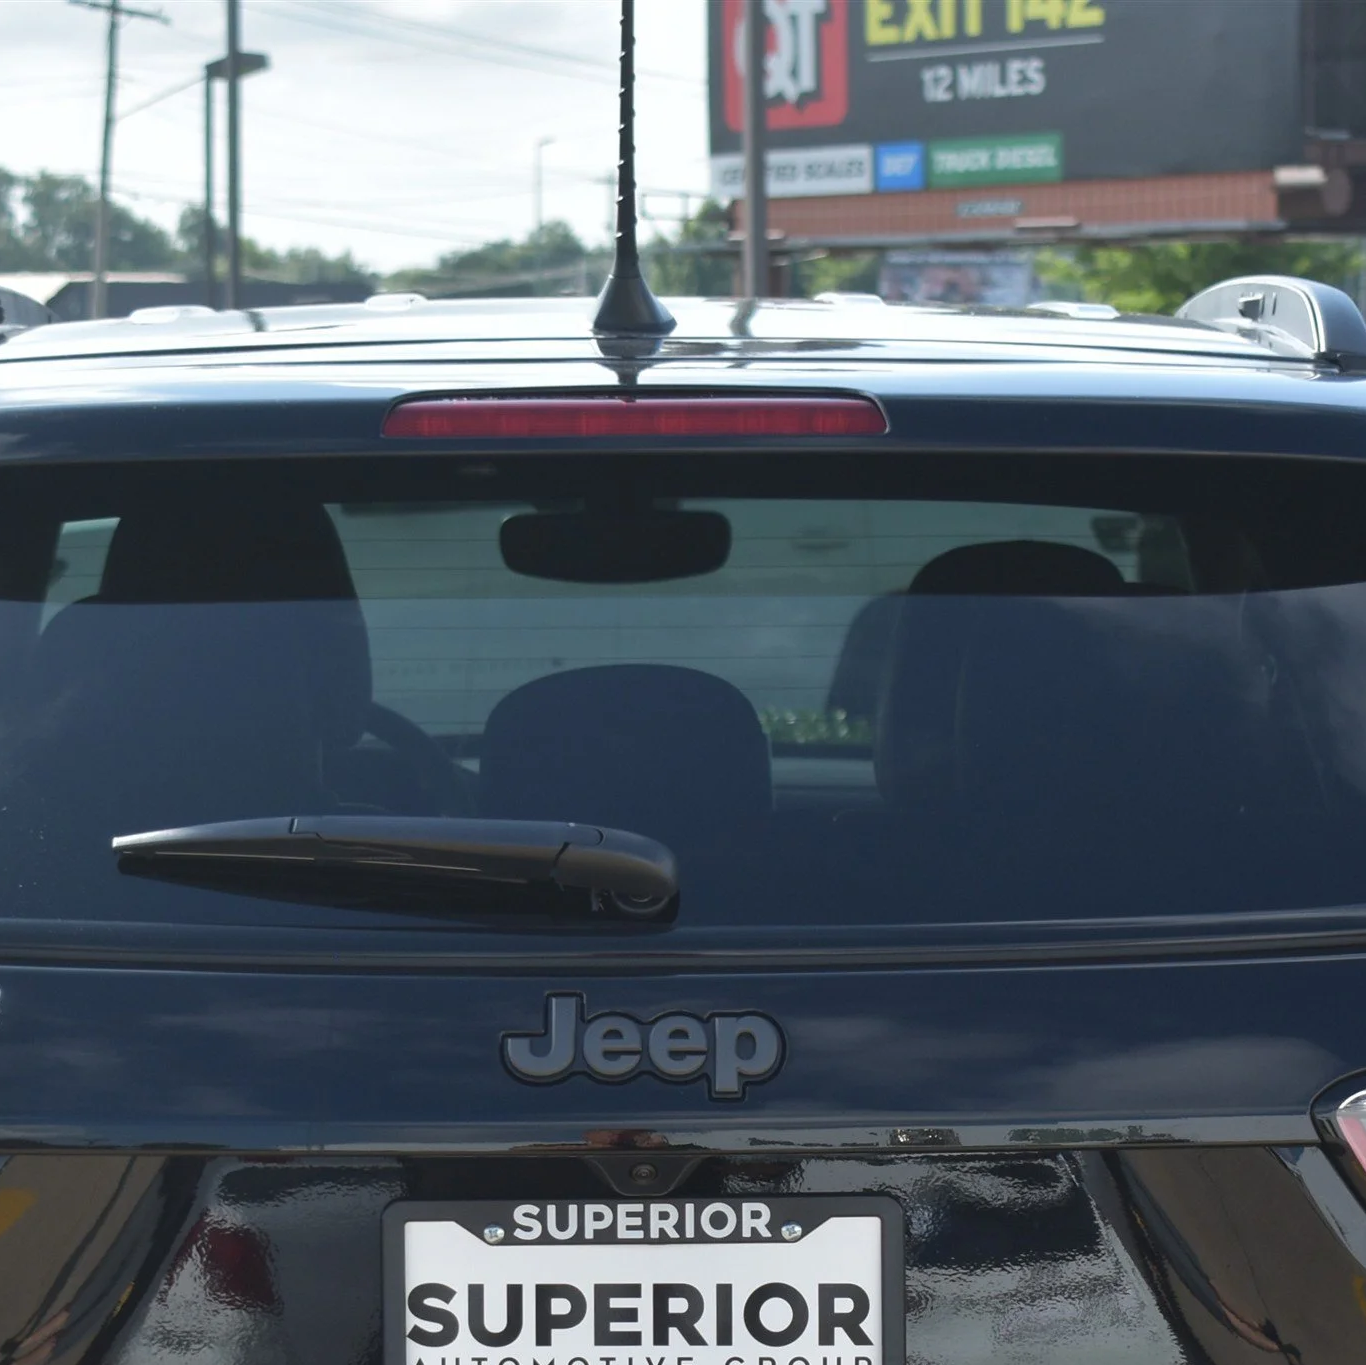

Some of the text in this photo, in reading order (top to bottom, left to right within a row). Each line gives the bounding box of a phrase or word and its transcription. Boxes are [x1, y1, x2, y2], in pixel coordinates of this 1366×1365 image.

[921, 57, 1047, 102] 12 MILES
[503, 993, 782, 1098] Jeep
[512, 1202, 773, 1241] SUPERIOR
[406, 1281, 874, 1348] SUPERIOR
